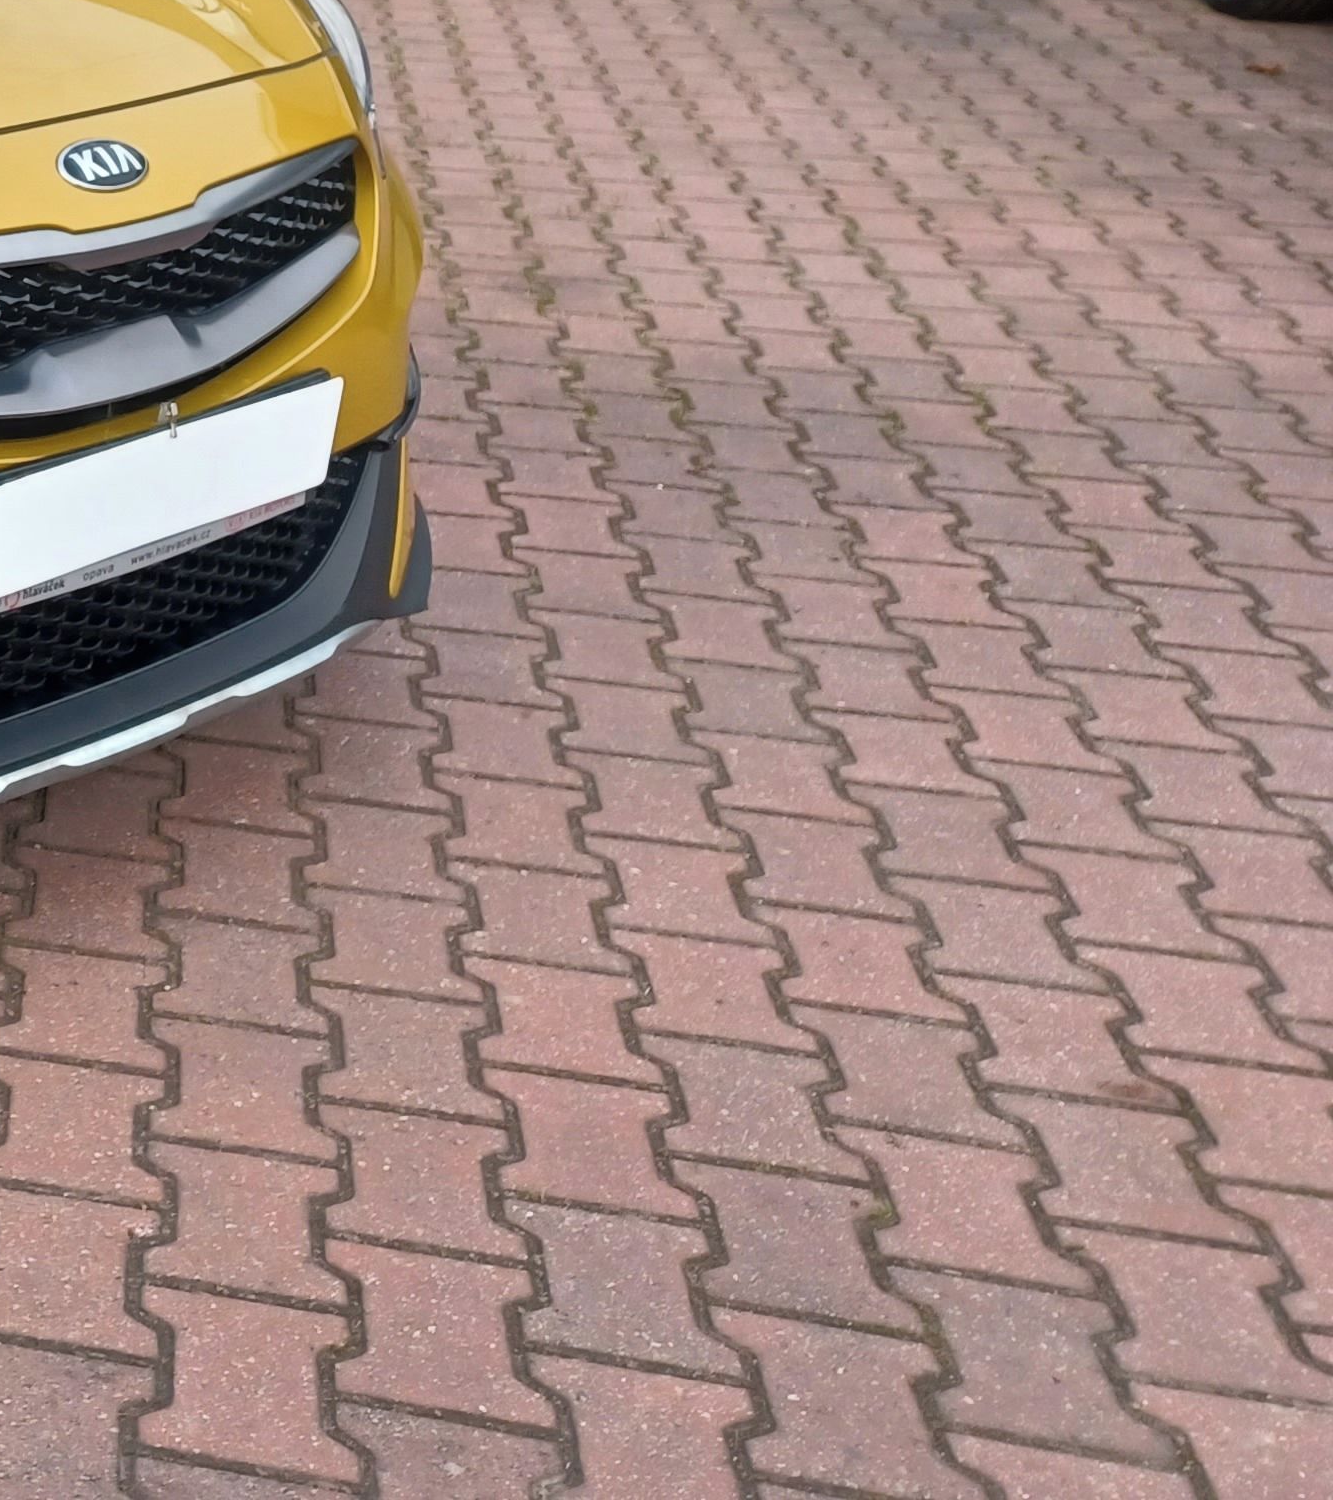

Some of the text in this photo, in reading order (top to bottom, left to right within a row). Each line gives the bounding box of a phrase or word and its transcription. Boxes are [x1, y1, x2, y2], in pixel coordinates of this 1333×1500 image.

[68, 143, 143, 182] KIA
[22, 578, 65, 600] hlaváček
[83, 563, 115, 582] opava
